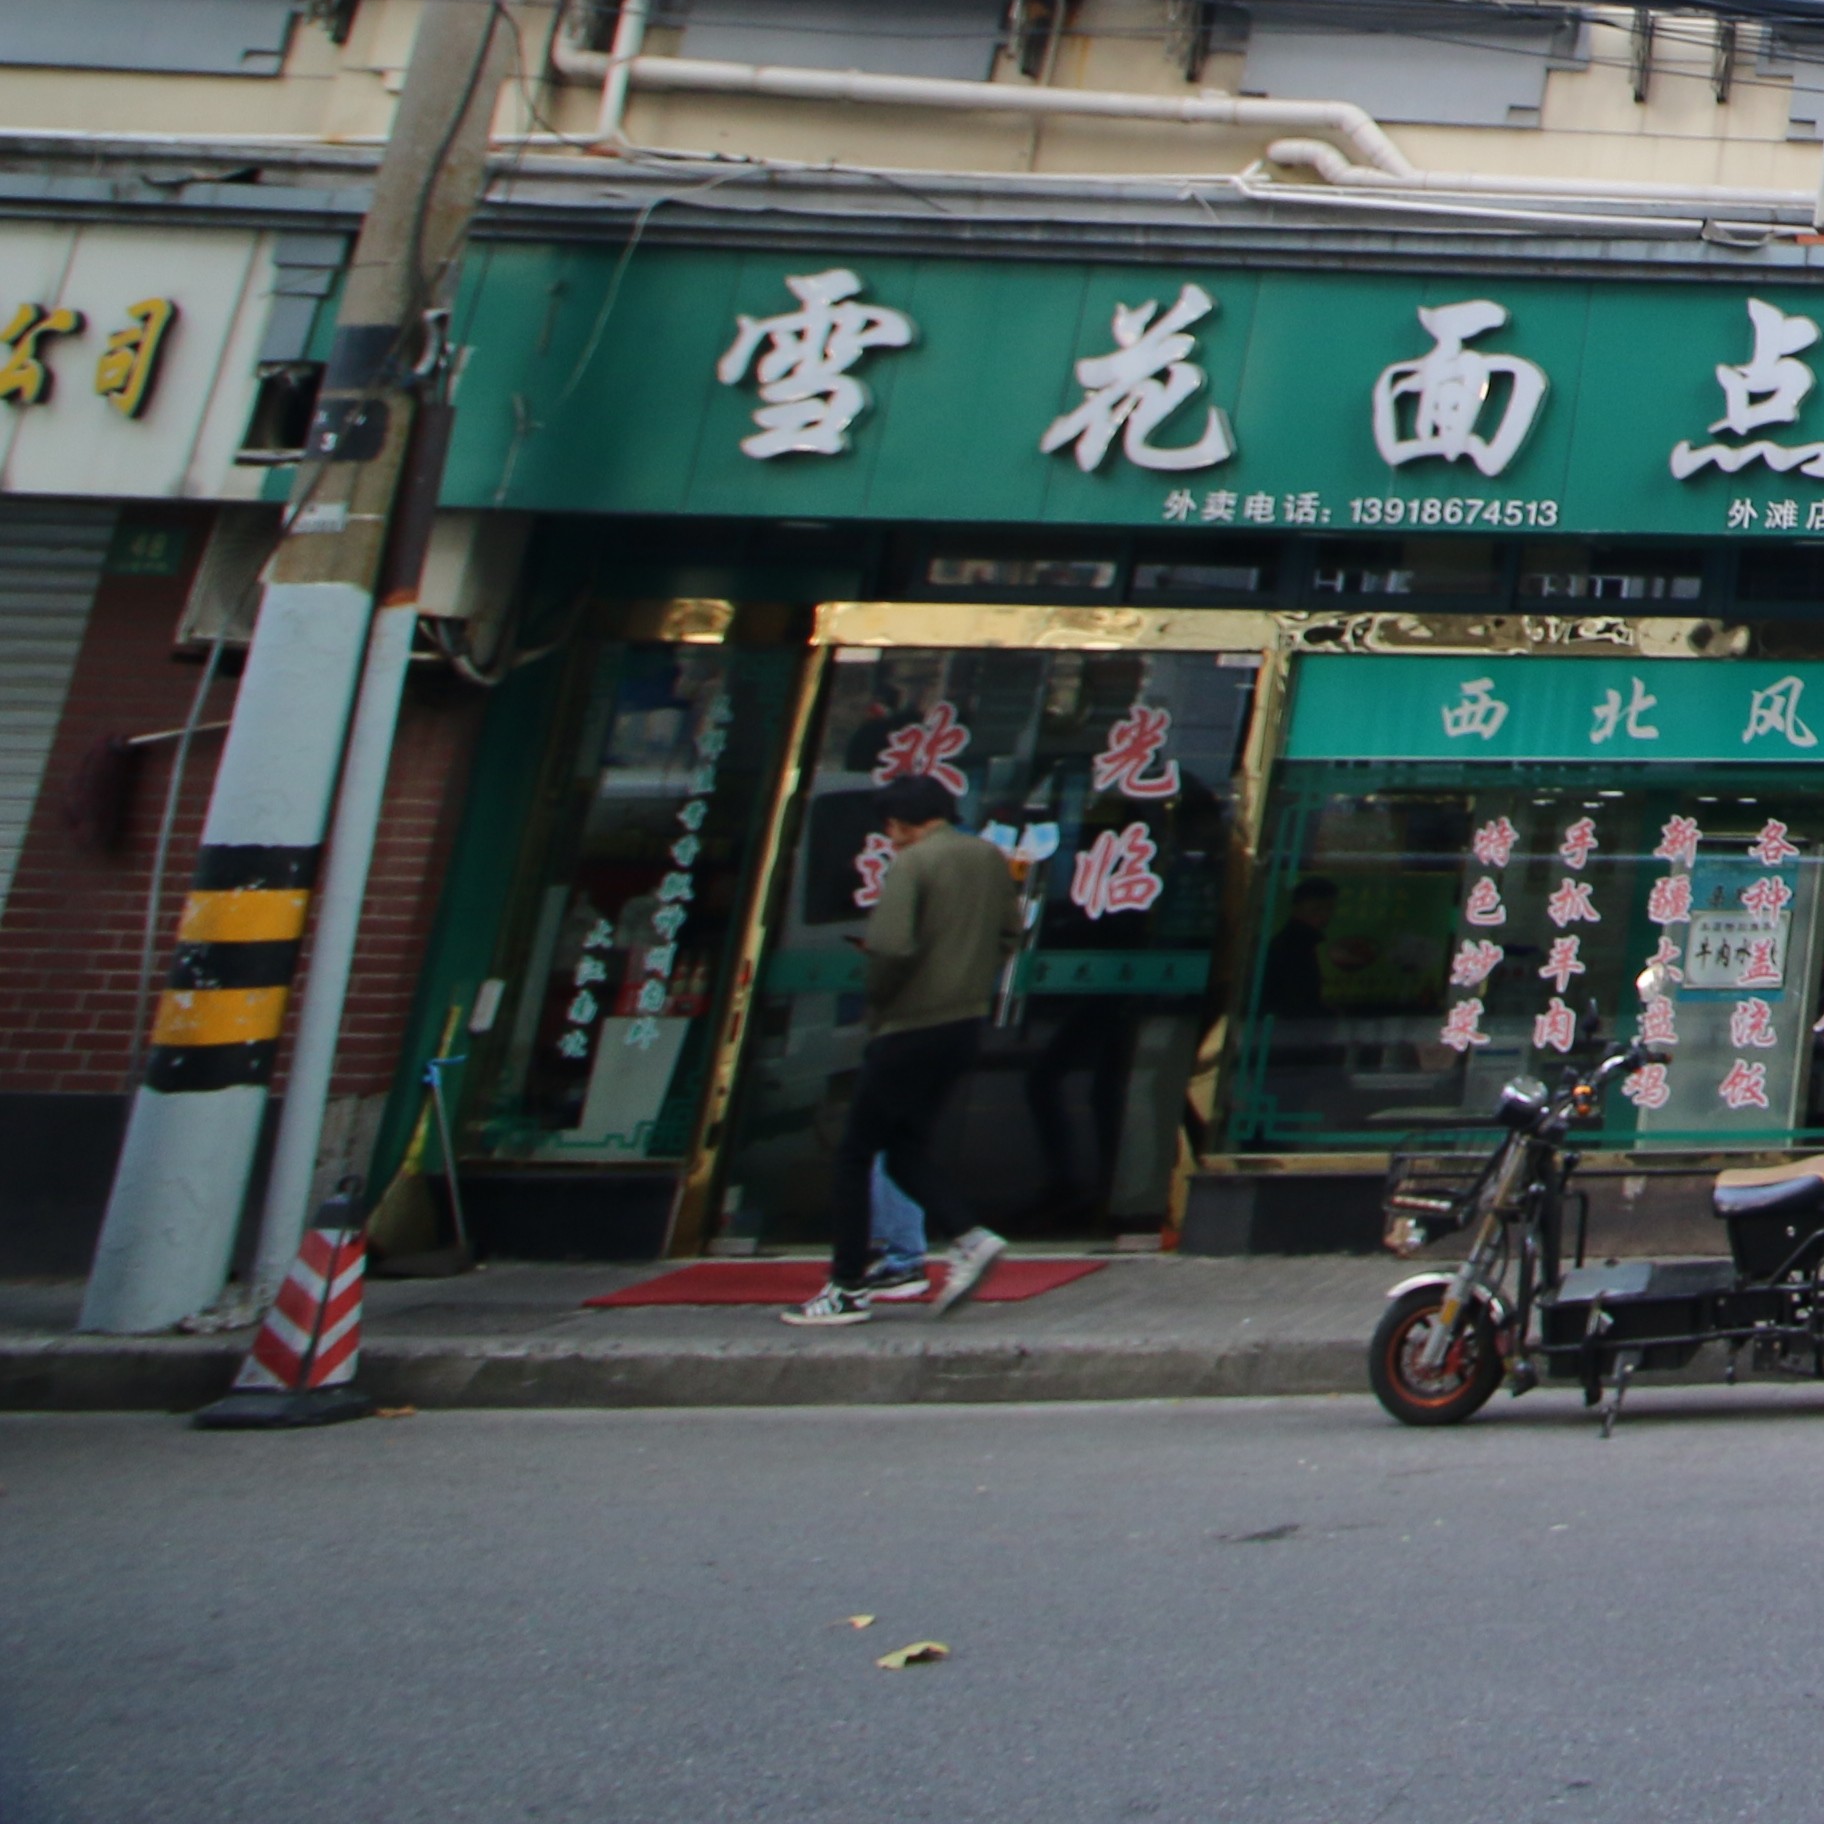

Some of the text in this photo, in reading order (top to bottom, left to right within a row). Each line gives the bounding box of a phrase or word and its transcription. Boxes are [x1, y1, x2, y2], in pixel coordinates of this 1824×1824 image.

[1349, 497, 1560, 527] 13918674513
[1071, 705, 1181, 920] 光临
[1440, 815, 1520, 1052] 特色炒菜
[1719, 818, 1801, 1109] 各种盖浇饭
